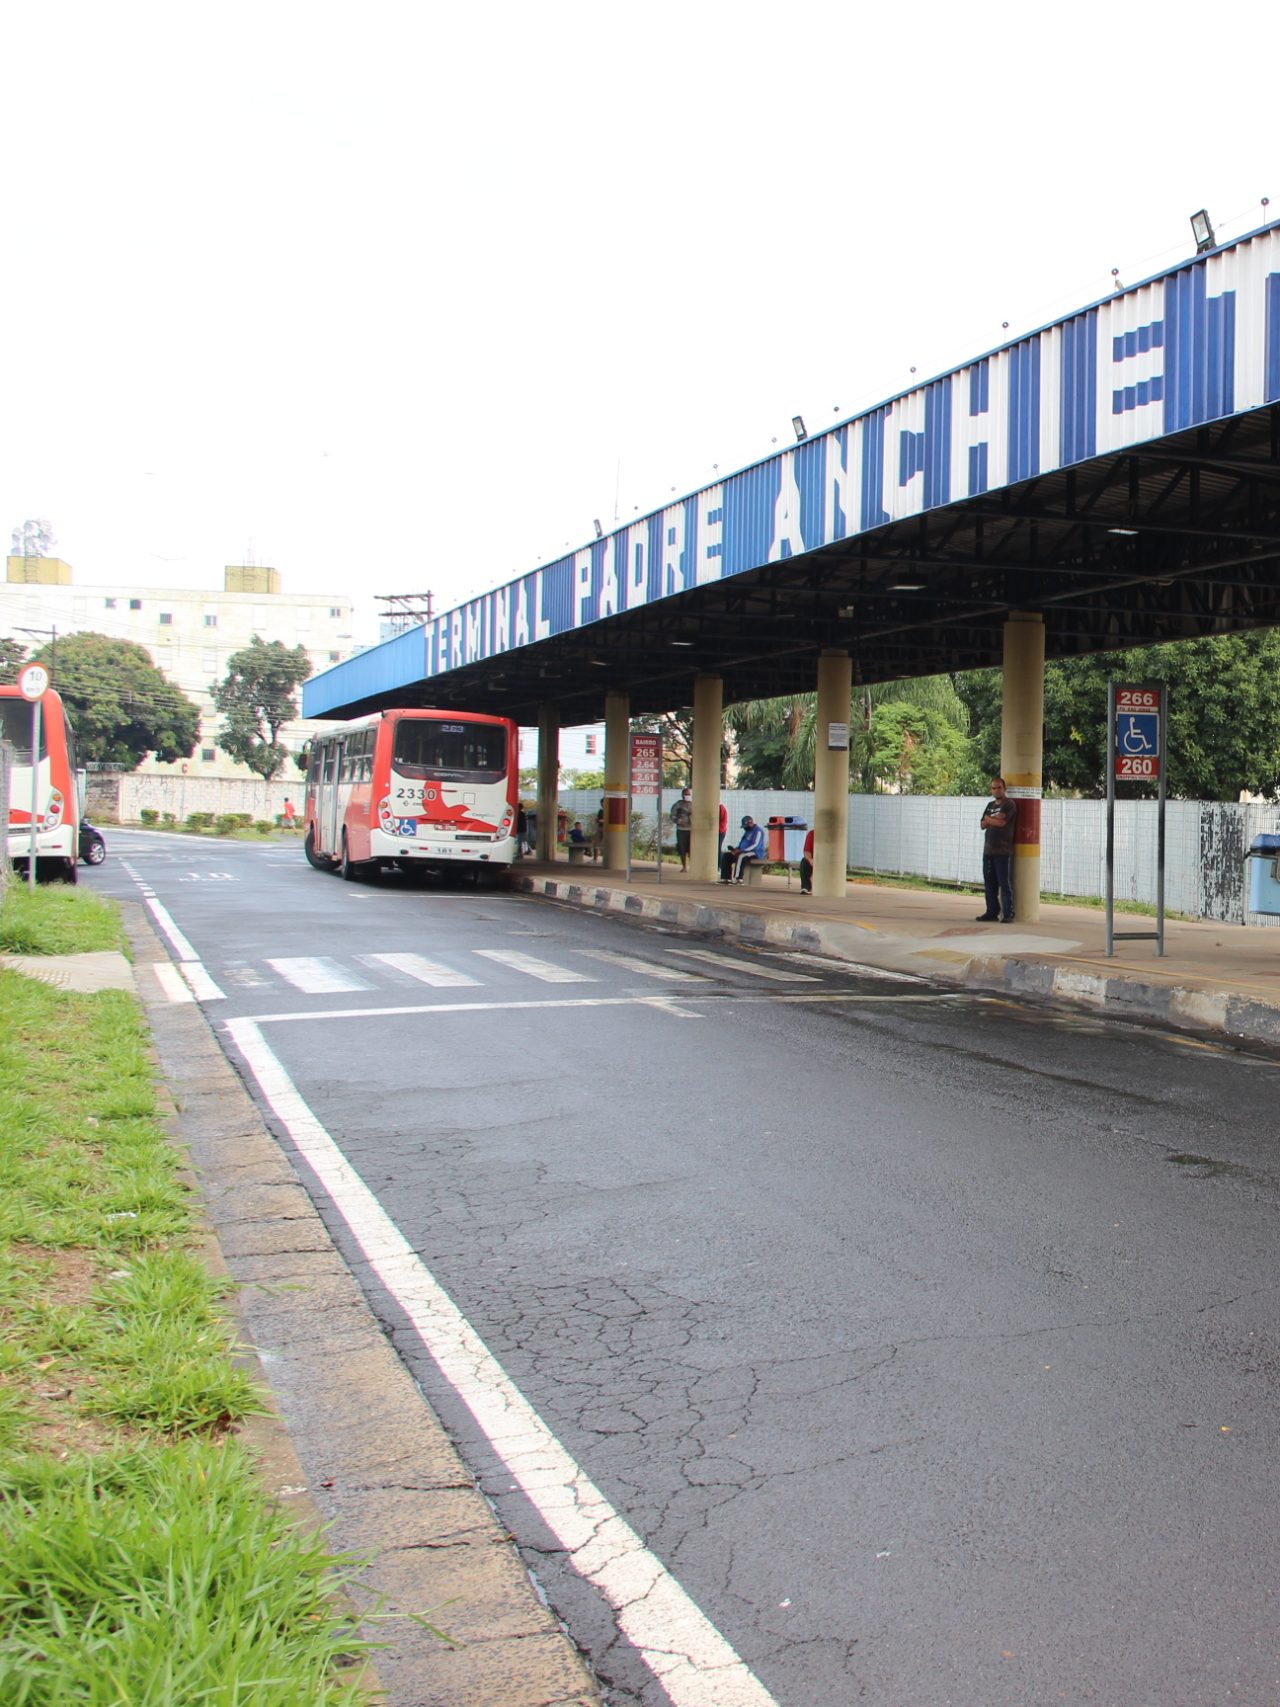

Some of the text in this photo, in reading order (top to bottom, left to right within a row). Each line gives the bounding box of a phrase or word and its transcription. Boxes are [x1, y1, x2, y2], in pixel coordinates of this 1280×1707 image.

[424, 570, 550, 676] TERMINAL
[574, 484, 723, 627] PADRE
[1121, 692, 1153, 706] 266
[637, 749, 655, 757] 265
[1122, 759, 1153, 774] 260
[397, 788, 435, 800] 2330
